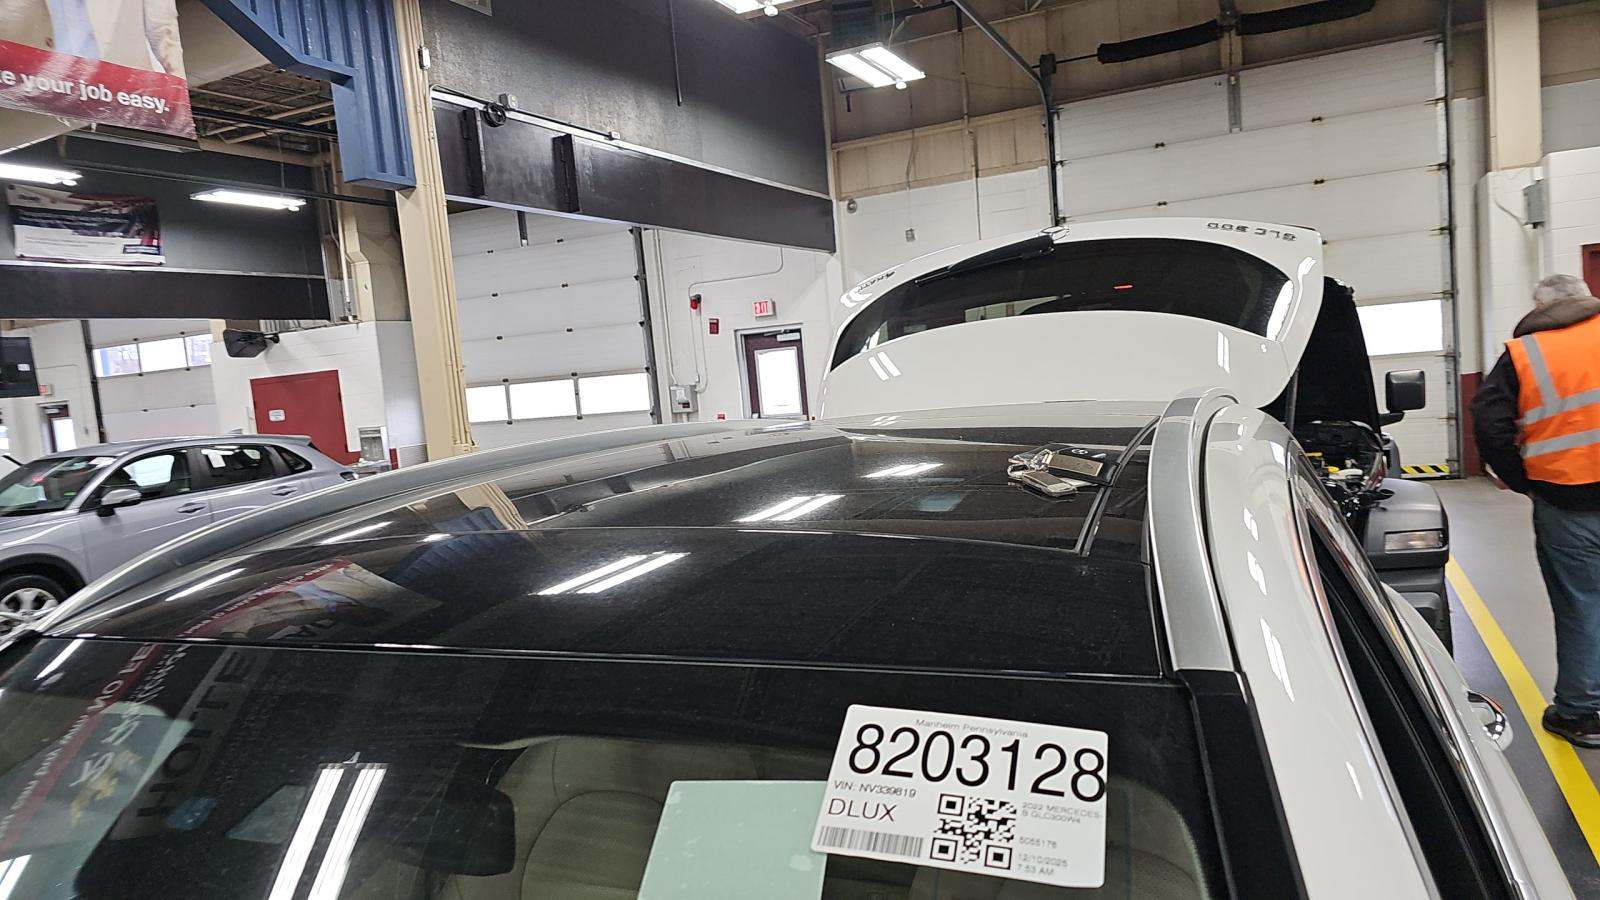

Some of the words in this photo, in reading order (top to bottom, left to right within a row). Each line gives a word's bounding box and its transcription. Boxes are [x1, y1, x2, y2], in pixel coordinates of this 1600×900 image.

[0, 69, 17, 87] e
[19, 73, 75, 94] your
[78, 80, 113, 103] job
[116, 91, 170, 114] easy.
[915, 718, 960, 731] Manheim
[962, 723, 1029, 739] Pennsylvania
[848, 723, 1107, 803] 8203128
[834, 780, 855, 792] VIN:
[828, 797, 897, 822] DLUX
[1017, 852, 1069, 868] 12/10/2025
[1039, 866, 1056, 877] AM
